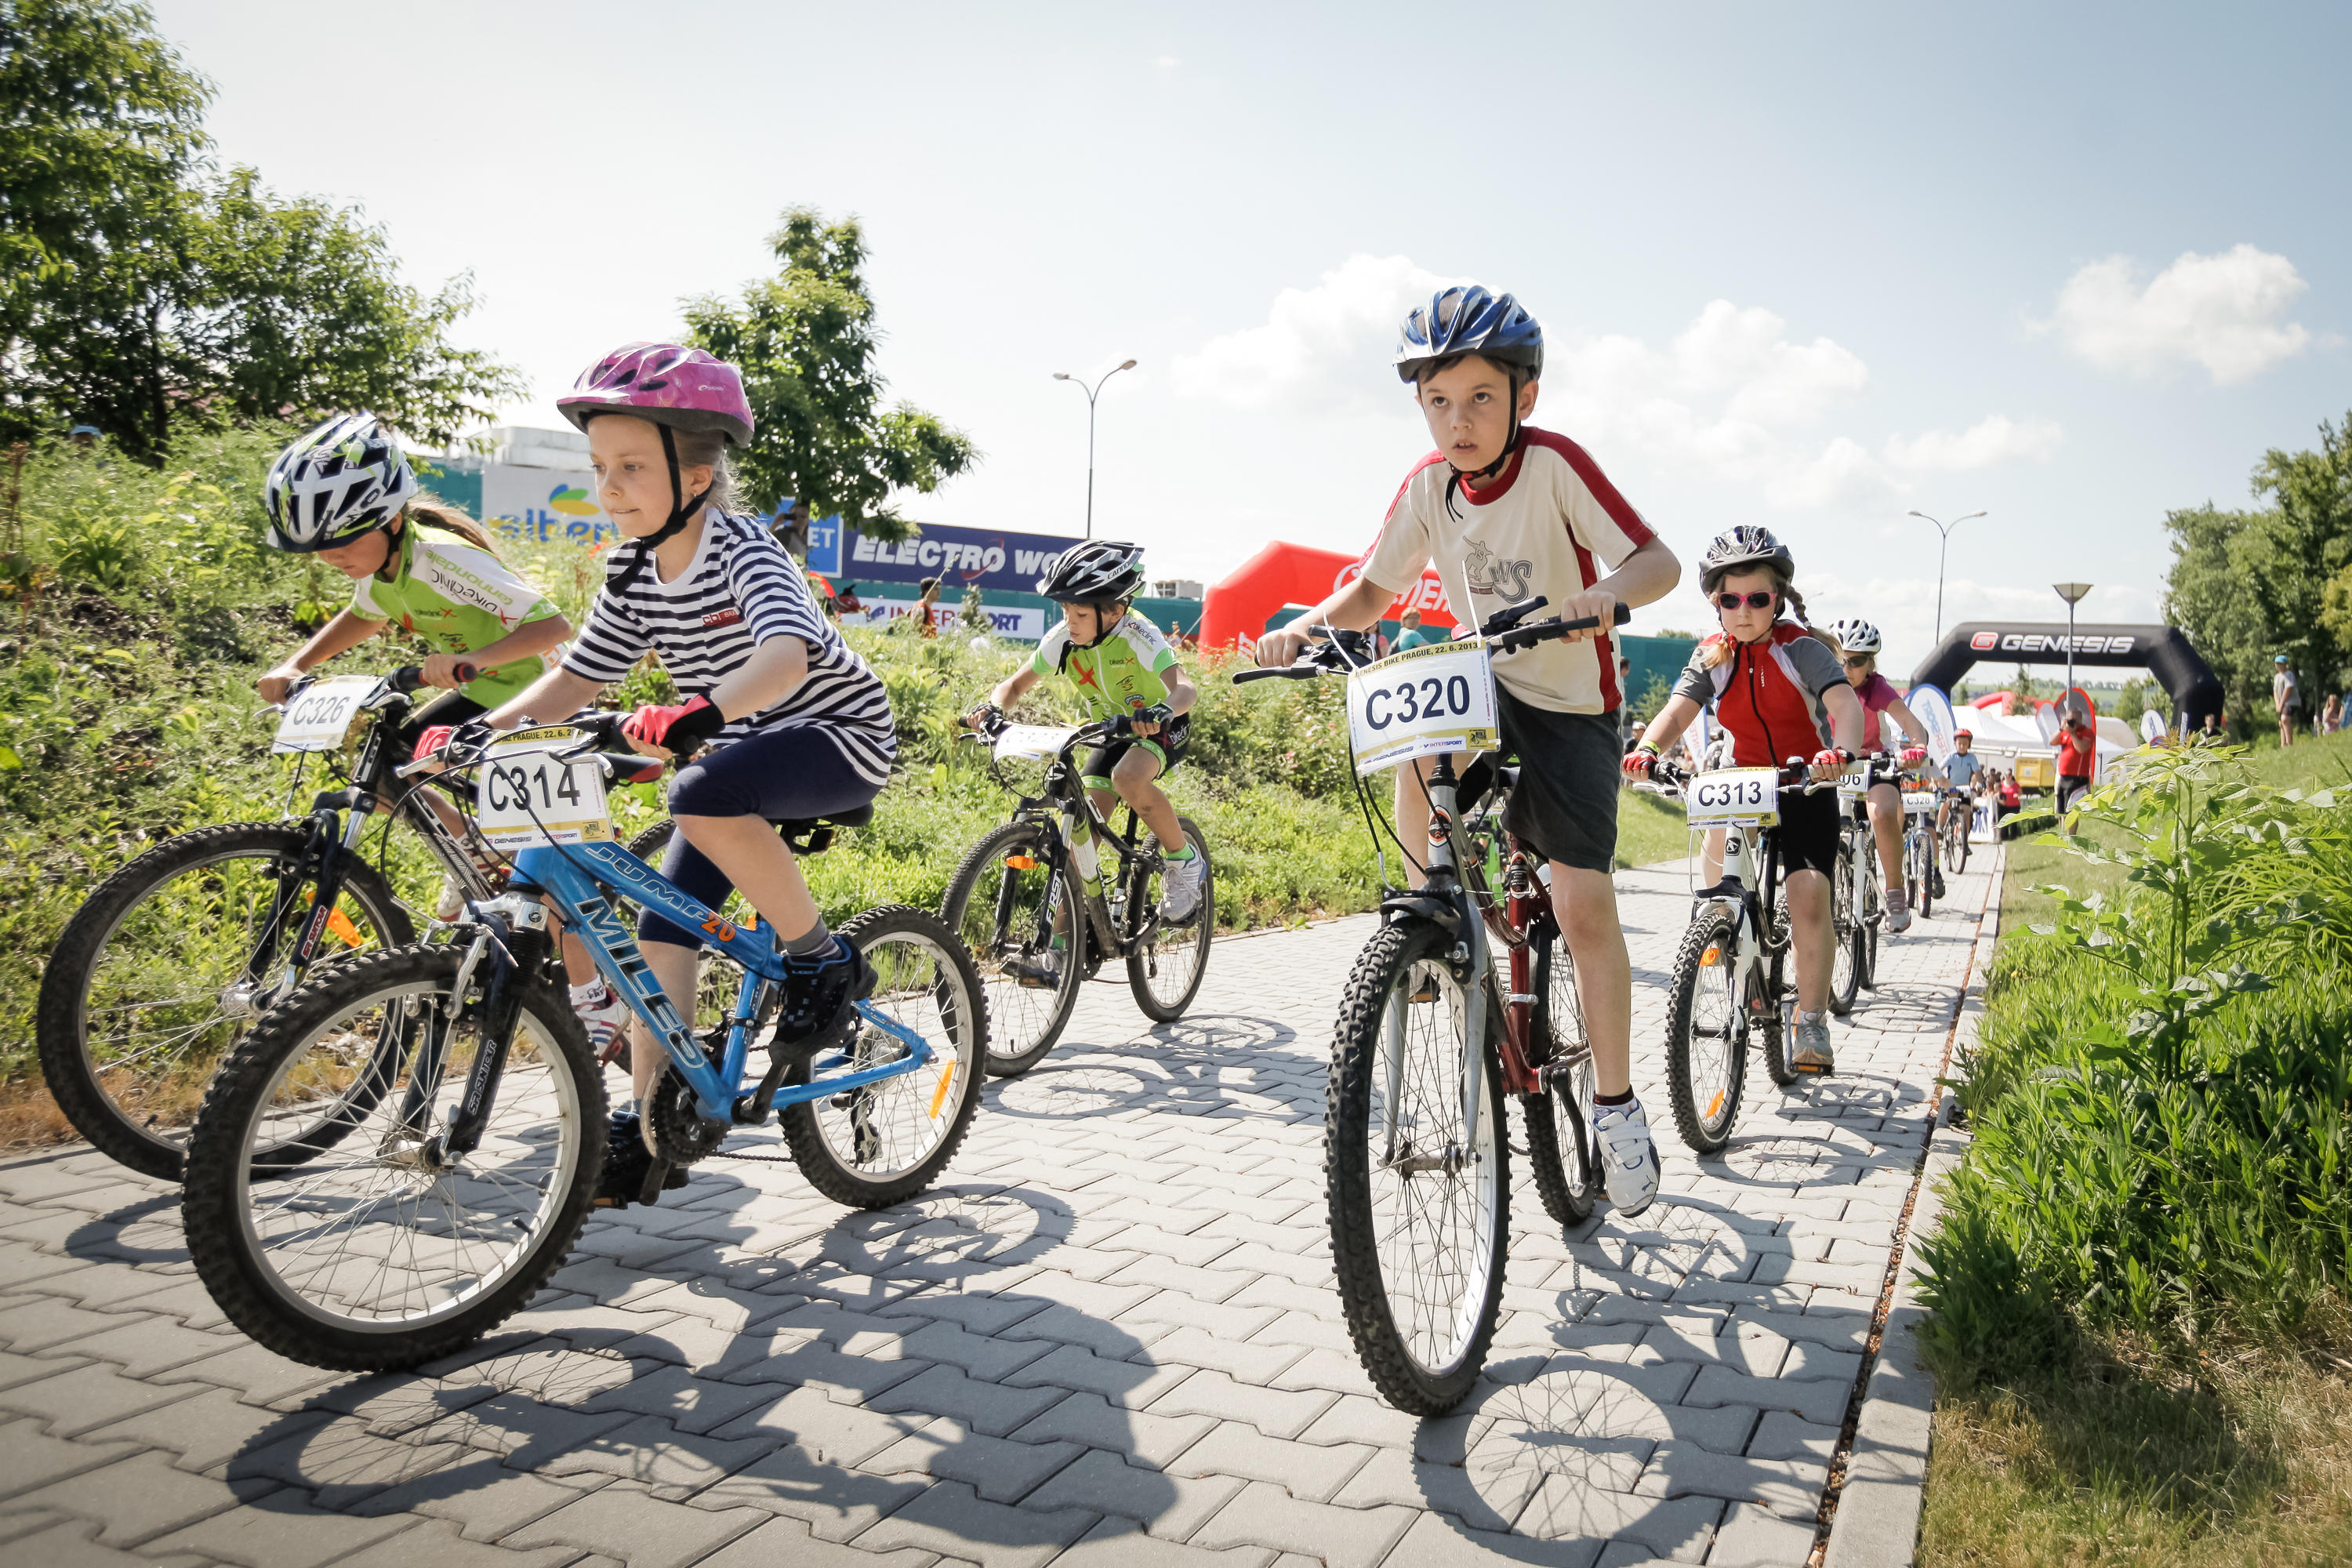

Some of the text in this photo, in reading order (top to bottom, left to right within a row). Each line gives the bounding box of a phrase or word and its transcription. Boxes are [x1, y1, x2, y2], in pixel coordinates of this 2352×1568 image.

[808, 526, 836, 549] ET
[852, 534, 1061, 575] ELECTRO WO
[426, 550, 514, 605] cannondale
[891, 606, 1022, 631] INERORT
[1384, 656, 1400, 667] BIKE
[1401, 648, 1434, 661] PRAGUE,
[1435, 645, 1448, 654] 22.
[1458, 642, 1479, 651] 2013
[2001, 634, 2135, 654] GENESIS
[293, 696, 351, 726] C326
[1366, 675, 1470, 731] C320
[513, 731, 543, 742] PRAGUE,
[544, 730, 557, 739] 22.
[488, 764, 581, 812] C314
[1698, 781, 1762, 807] C313
[1907, 796, 1930, 805] C328
[494, 836, 532, 844] GENESIS
[1046, 869, 1062, 926] FIRST
[701, 911, 735, 942] 20
[575, 896, 706, 1068] MILES
[466, 1040, 498, 1114] SR SUNTOUR
